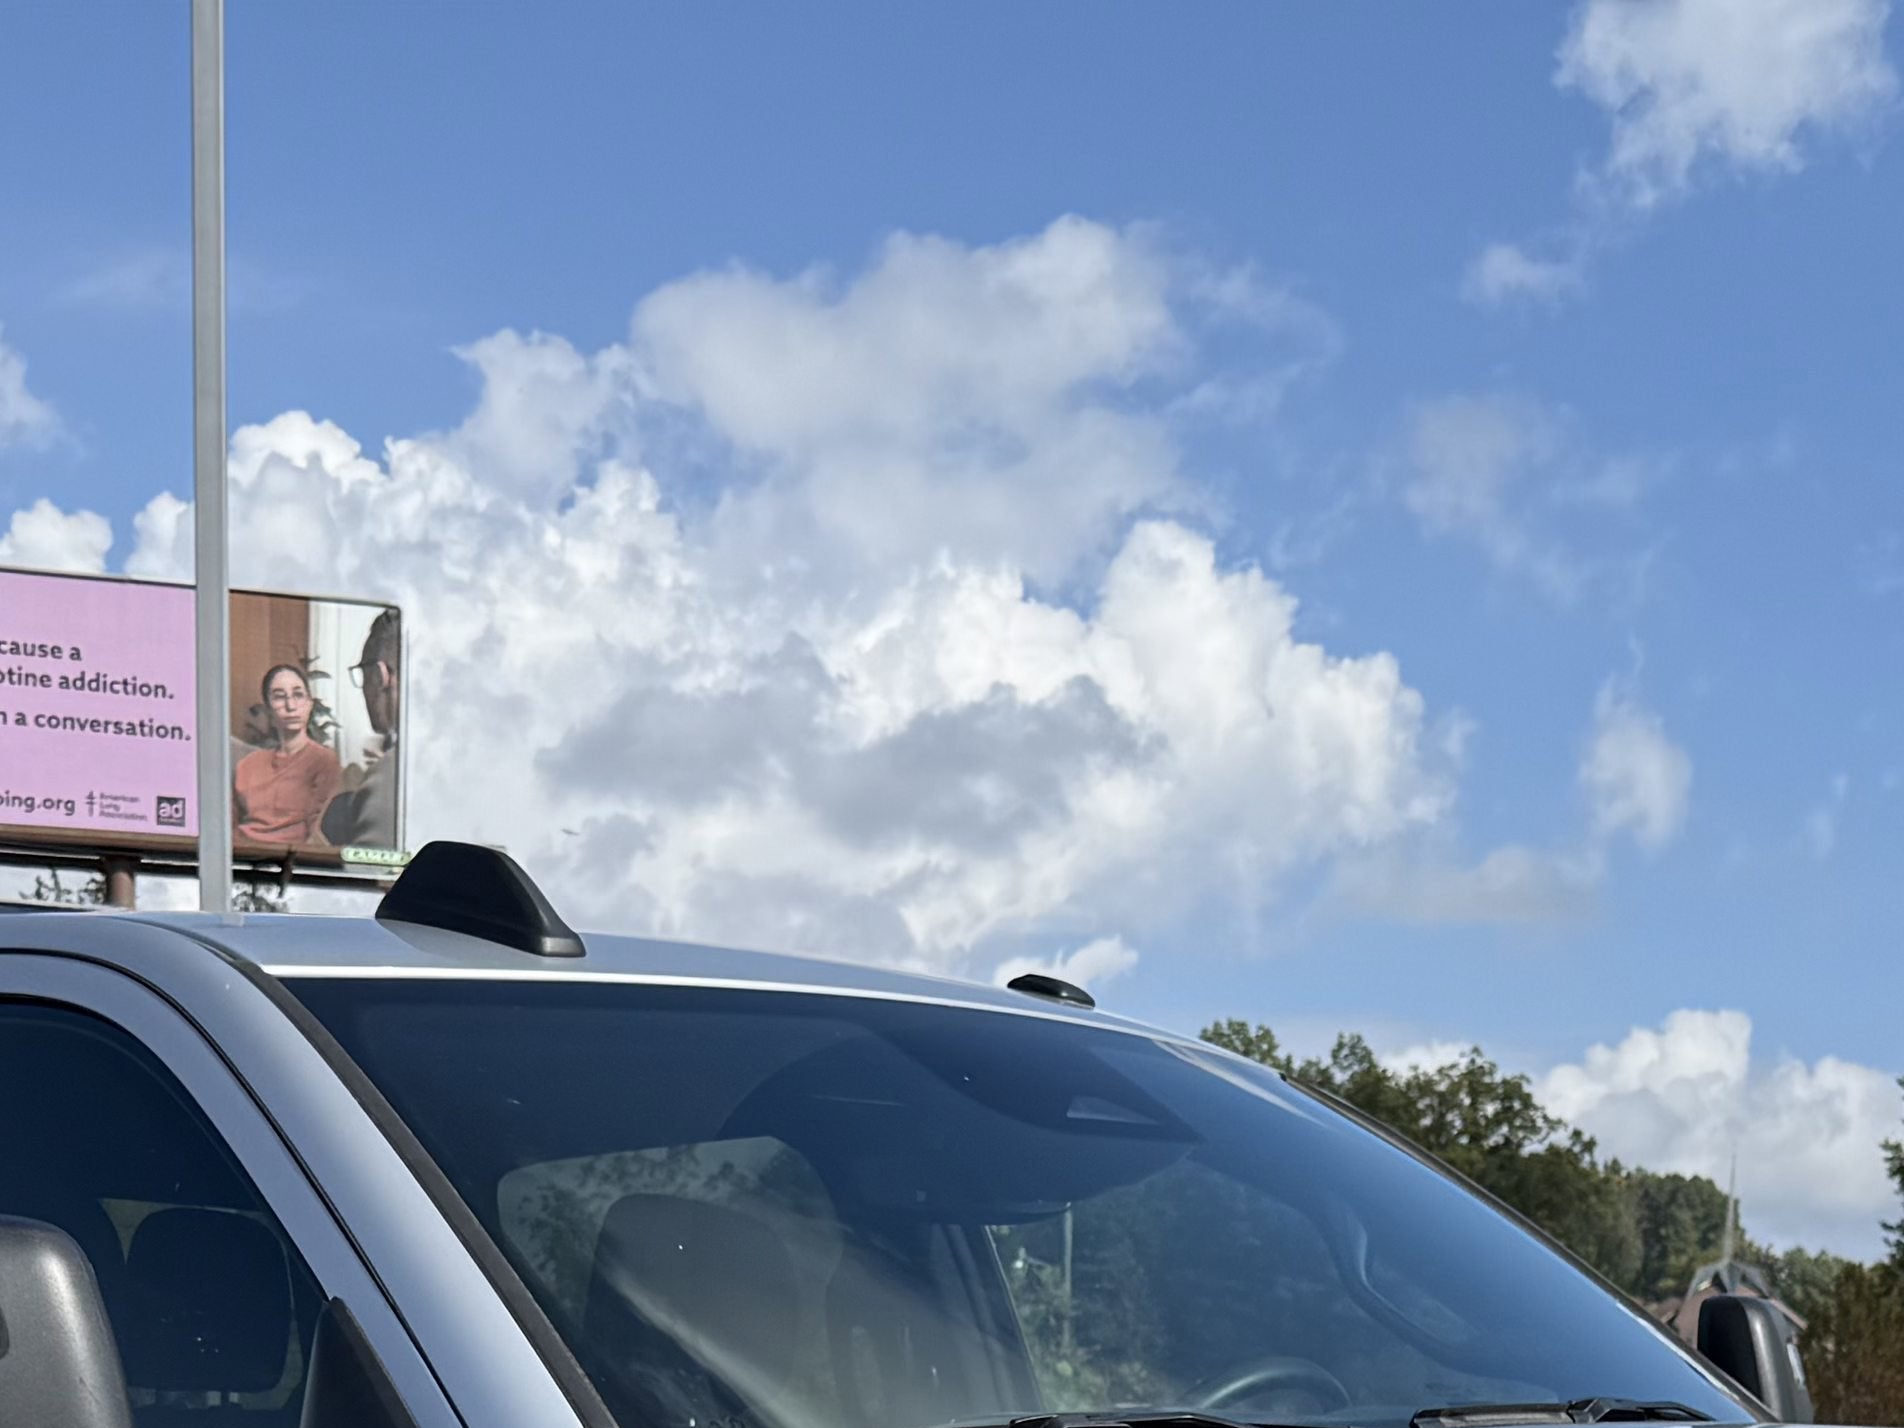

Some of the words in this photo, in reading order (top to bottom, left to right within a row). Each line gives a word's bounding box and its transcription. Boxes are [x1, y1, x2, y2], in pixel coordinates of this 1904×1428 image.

[69, 645, 82, 661] a
[58, 671, 174, 700] addiction.
[14, 712, 27, 726] a
[34, 713, 192, 742] conversation.
[159, 799, 183, 818] ad
